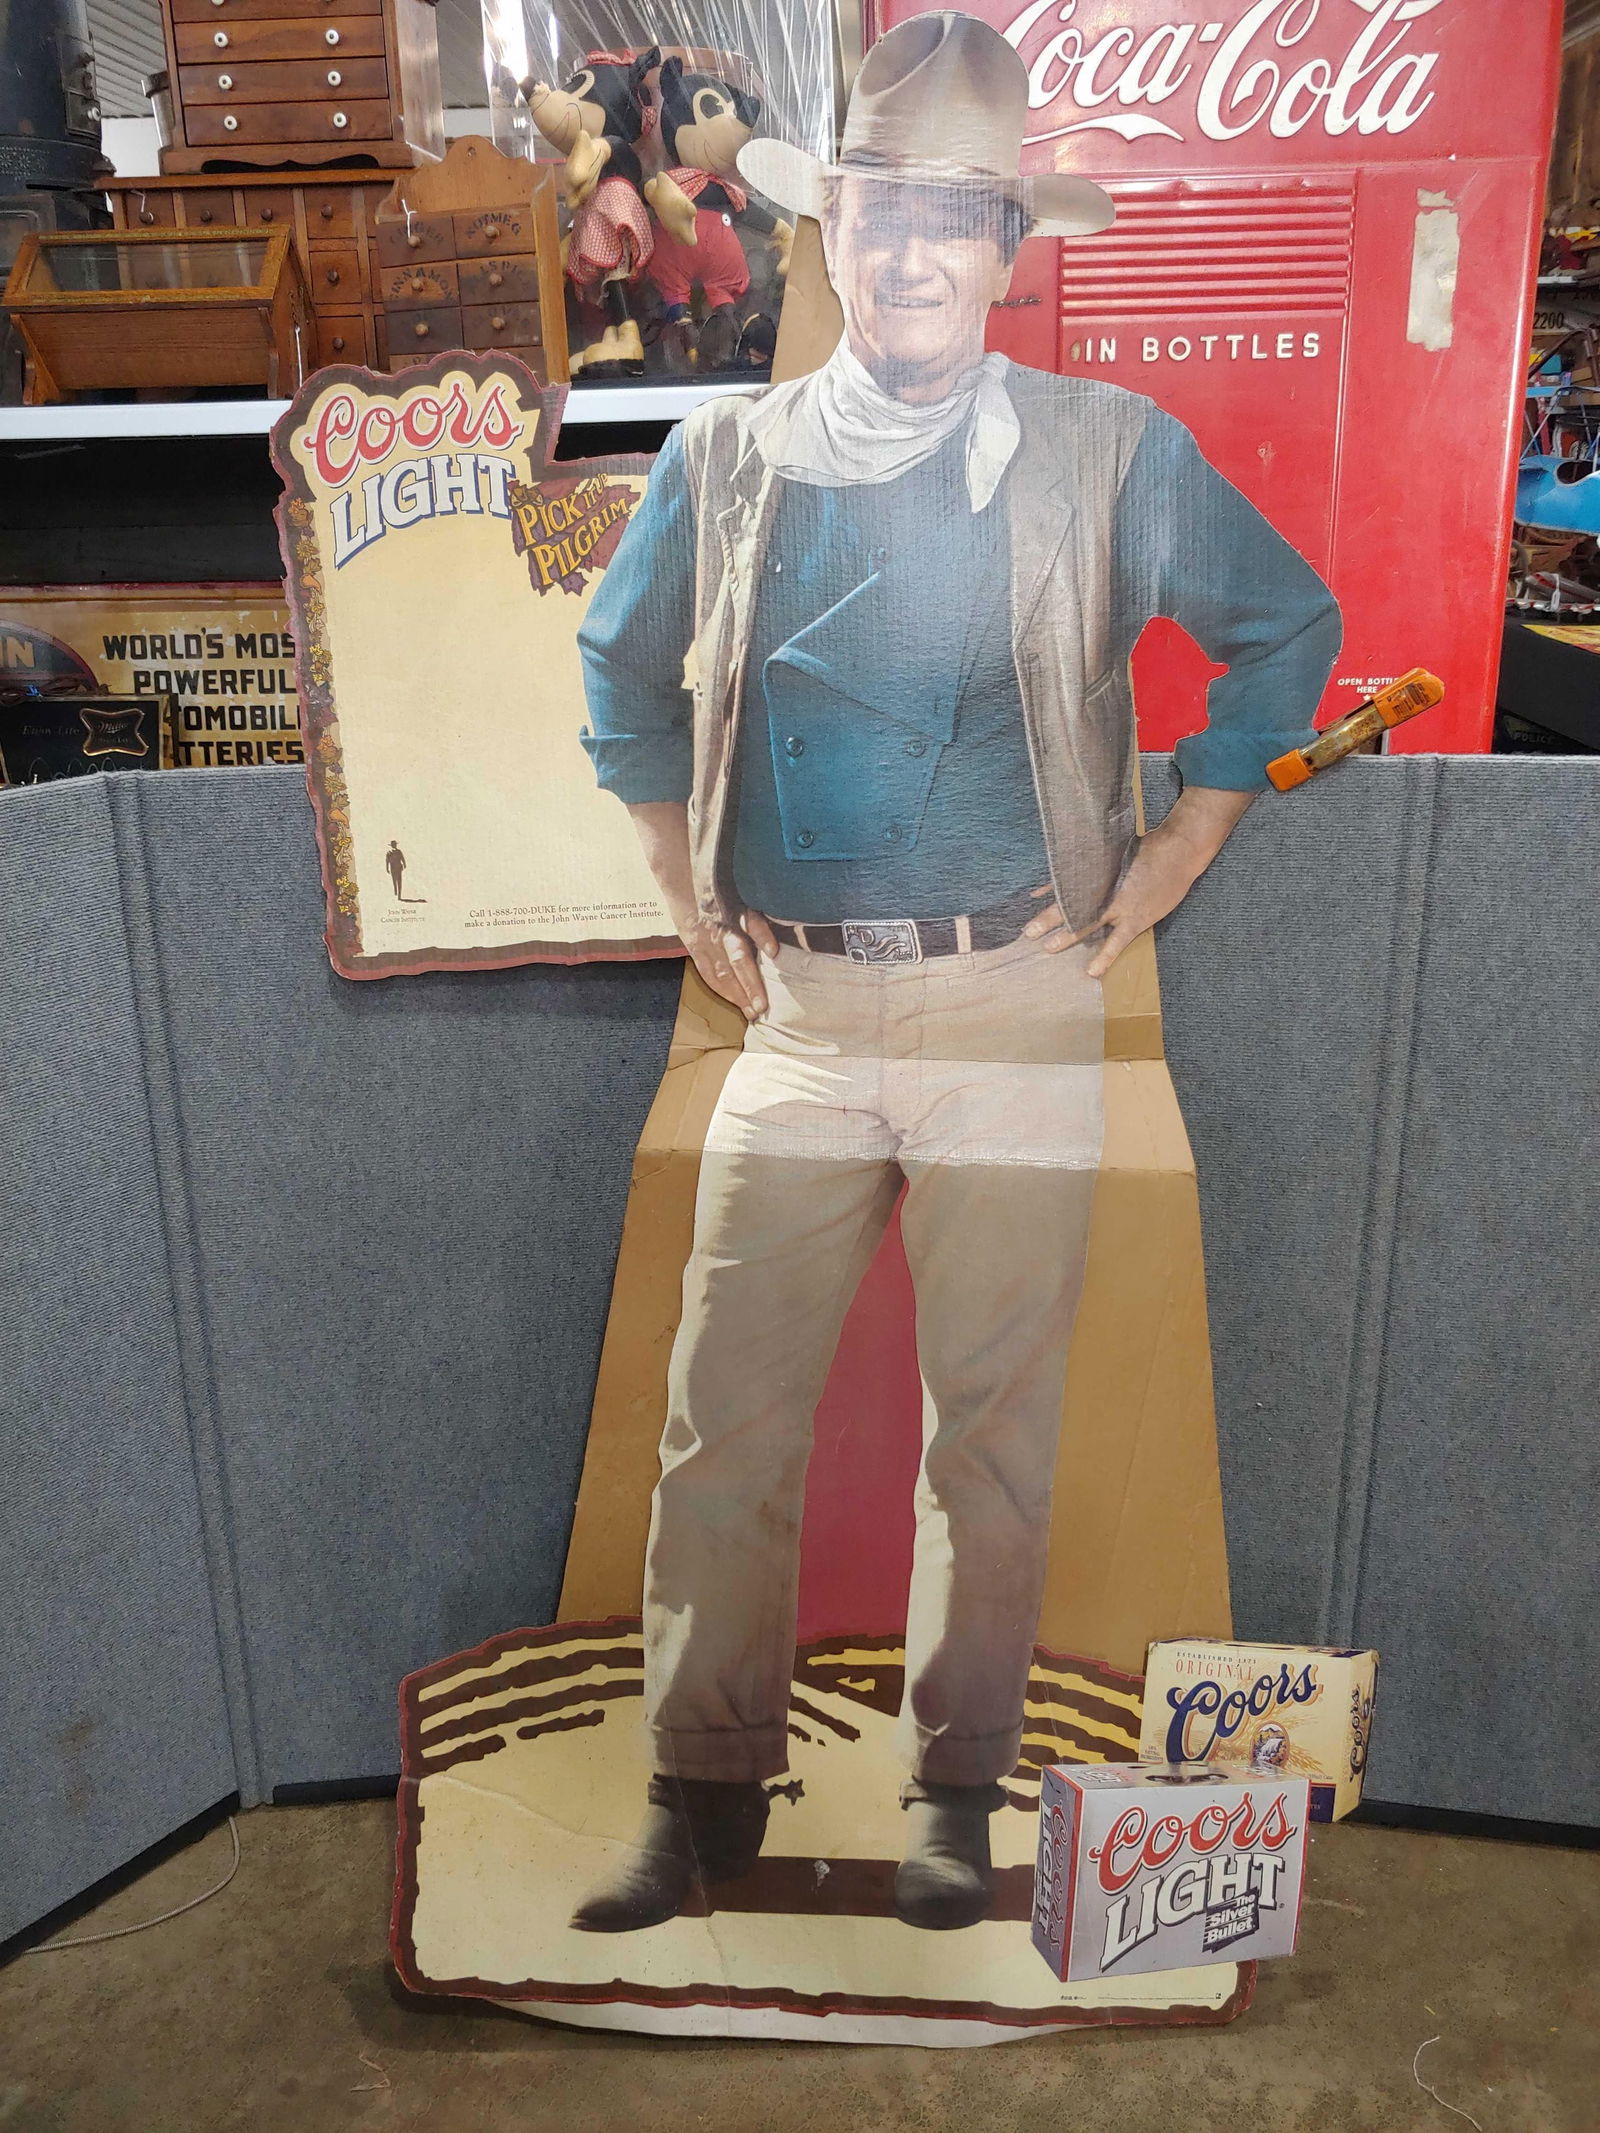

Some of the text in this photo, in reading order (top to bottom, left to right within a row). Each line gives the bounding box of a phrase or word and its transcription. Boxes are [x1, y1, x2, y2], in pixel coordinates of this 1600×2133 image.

[465, 213, 522, 238] NUTMEG
[1085, 333, 1320, 363] IN BOTTLES
[303, 383, 525, 488] Coors
[330, 453, 517, 570] LIGHT
[516, 494, 584, 546] PICK
[583, 487, 598, 509] IT
[532, 498, 630, 586] PILGRIM
[103, 627, 223, 661] WORLD'S
[134, 668, 297, 695] POWERFUL
[1337, 678, 1362, 686] OPEN
[1356, 685, 1378, 694] HERE
[178, 705, 300, 731] OMOBIL
[174, 741, 304, 766] TTERIES
[464, 919, 485, 928] make
[493, 917, 526, 926] donation
[537, 916, 550, 924] the
[551, 914, 570, 924] John
[572, 913, 598, 922] Wayne
[600, 911, 627, 920] Cancer
[469, 909, 485, 918] Call
[559, 904, 570, 913] for
[593, 901, 637, 911] information
[1176, 1652, 1233, 1662] ESTABLISHED
[1176, 1659, 1254, 1681] ORIGINAL
[1166, 1663, 1319, 1763] Coors
[1088, 1791, 1298, 1895] Coors
[1039, 1799, 1053, 1936] LIGHT
[1050, 1799, 1068, 1947] Coors
[1100, 1852, 1286, 1973] LIGHT
[1235, 1894, 1256, 1907] The
[1208, 1903, 1255, 1928] Silver
[1206, 1916, 1253, 1943] Bullet
